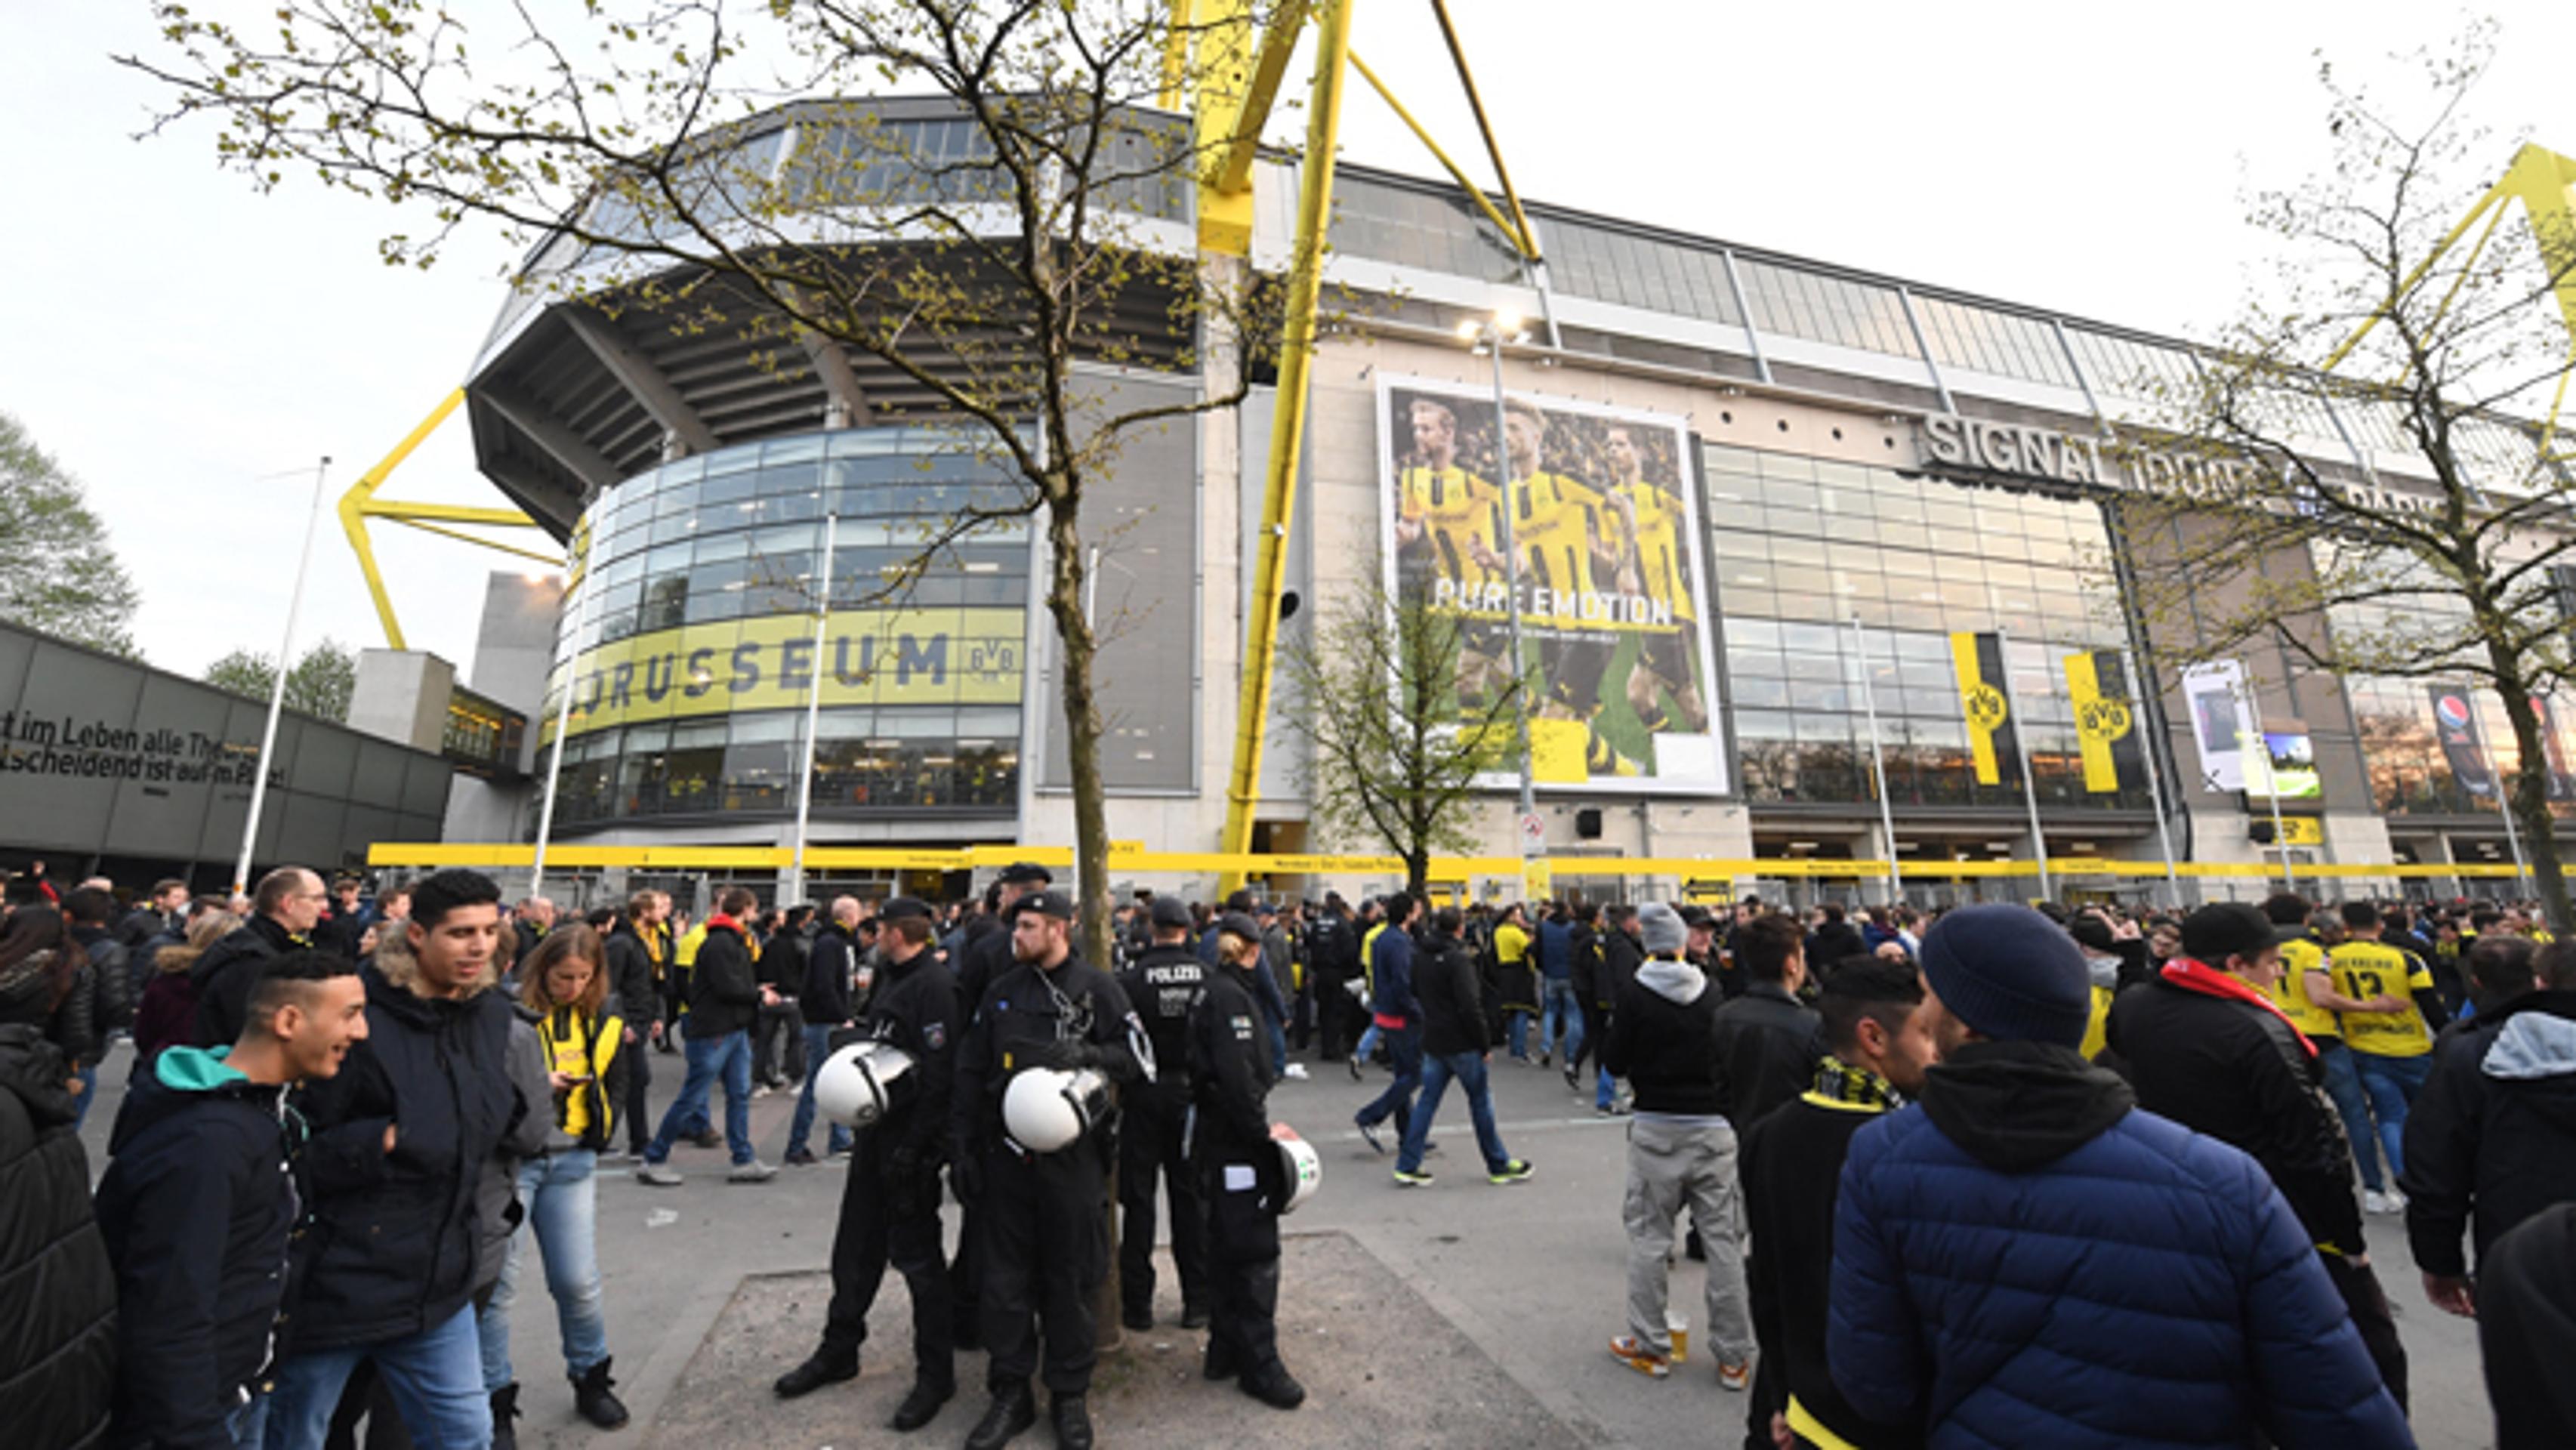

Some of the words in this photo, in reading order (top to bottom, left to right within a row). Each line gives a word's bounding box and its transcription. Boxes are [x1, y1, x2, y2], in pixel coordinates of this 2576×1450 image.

[1925, 412, 2121, 488] SIGNAL
[1434, 577, 1523, 615] PURE
[1533, 588, 1673, 626] EMOTION
[22, 711, 56, 746] im
[63, 717, 138, 751] Leben
[143, 728, 184, 755] alle
[146, 758, 172, 782] ist
[1146, 964, 1203, 984] POLIZEI
